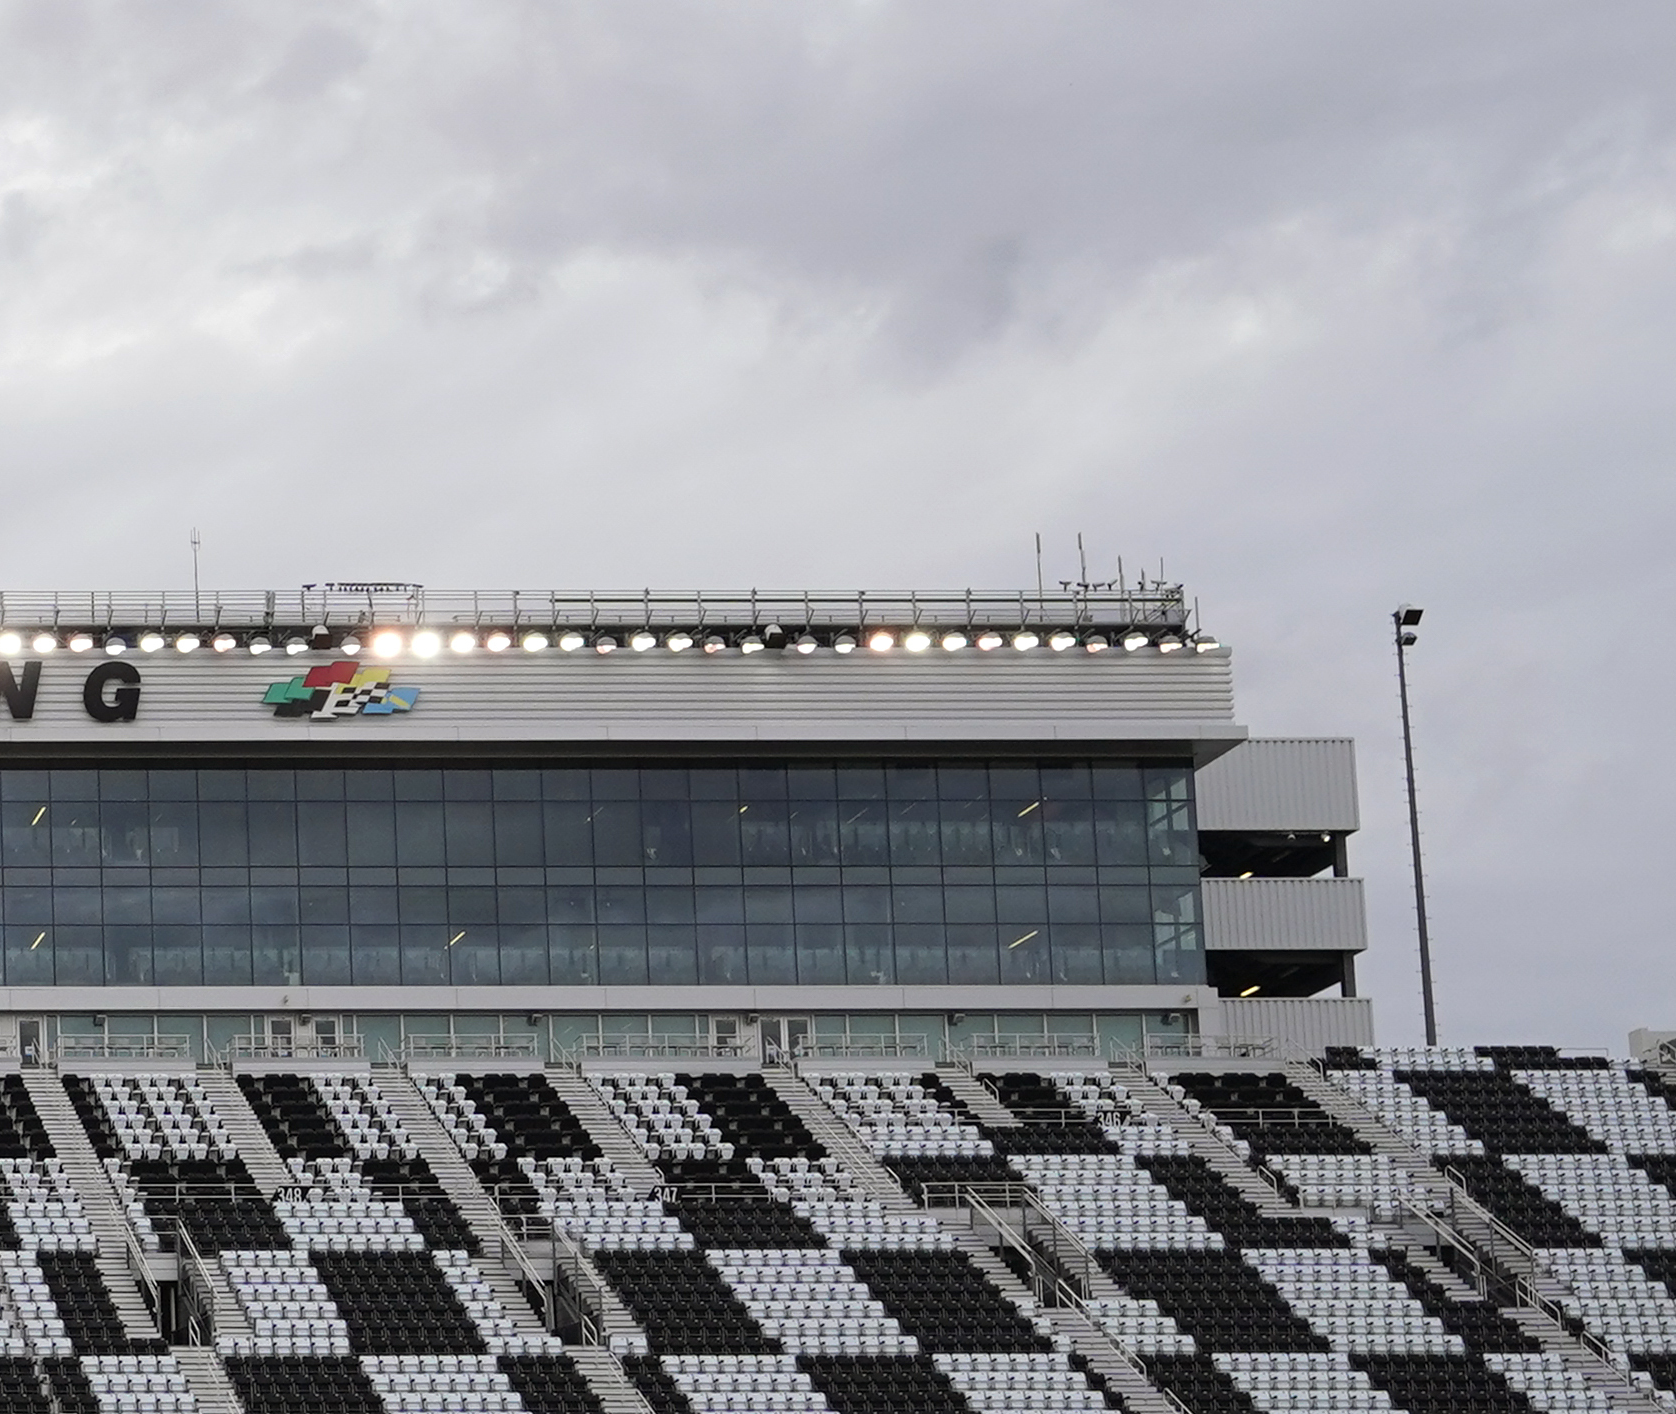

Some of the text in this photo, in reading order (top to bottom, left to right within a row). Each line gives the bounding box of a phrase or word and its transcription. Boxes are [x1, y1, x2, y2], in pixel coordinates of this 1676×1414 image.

[1096, 1111, 1121, 1127] 346
[277, 1187, 302, 1202] 348
[655, 1187, 678, 1202] 347
